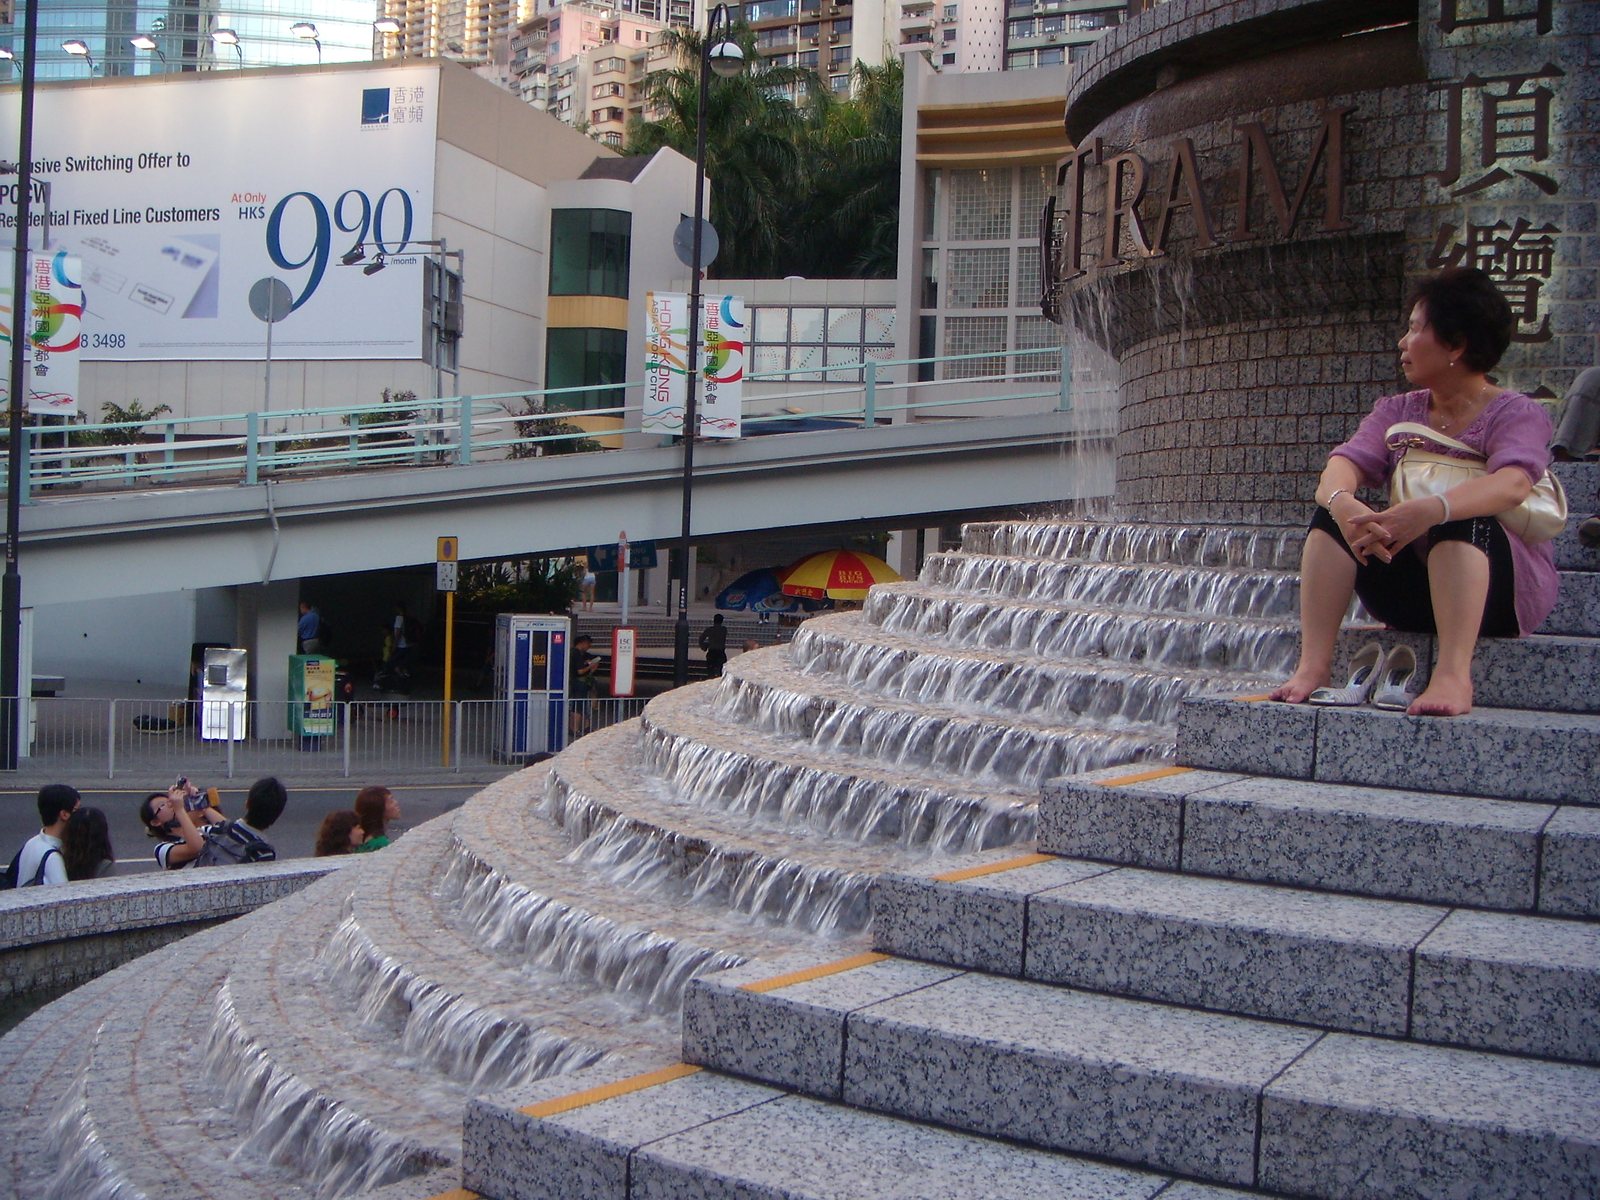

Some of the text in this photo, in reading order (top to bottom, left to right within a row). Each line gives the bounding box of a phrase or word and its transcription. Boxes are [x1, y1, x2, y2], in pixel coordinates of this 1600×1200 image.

[393, 86, 424, 104] 香港
[65, 154, 133, 173] Switching
[138, 152, 173, 169] Offer
[177, 152, 190, 167] to
[0, 183, 47, 205] PCW
[231, 192, 267, 204] At Only
[1056, 106, 1358, 282] TRAM
[0, 206, 220, 228] Resdetial Fixed Line Customers
[390, 256, 417, 265] /month
[33, 258, 51, 377] 香港亞洲國際都會
[92, 333, 126, 349] 3498
[657, 300, 672, 403] HONG KONG
[650, 335, 659, 374] WORLD
[649, 376, 658, 401] CITY
